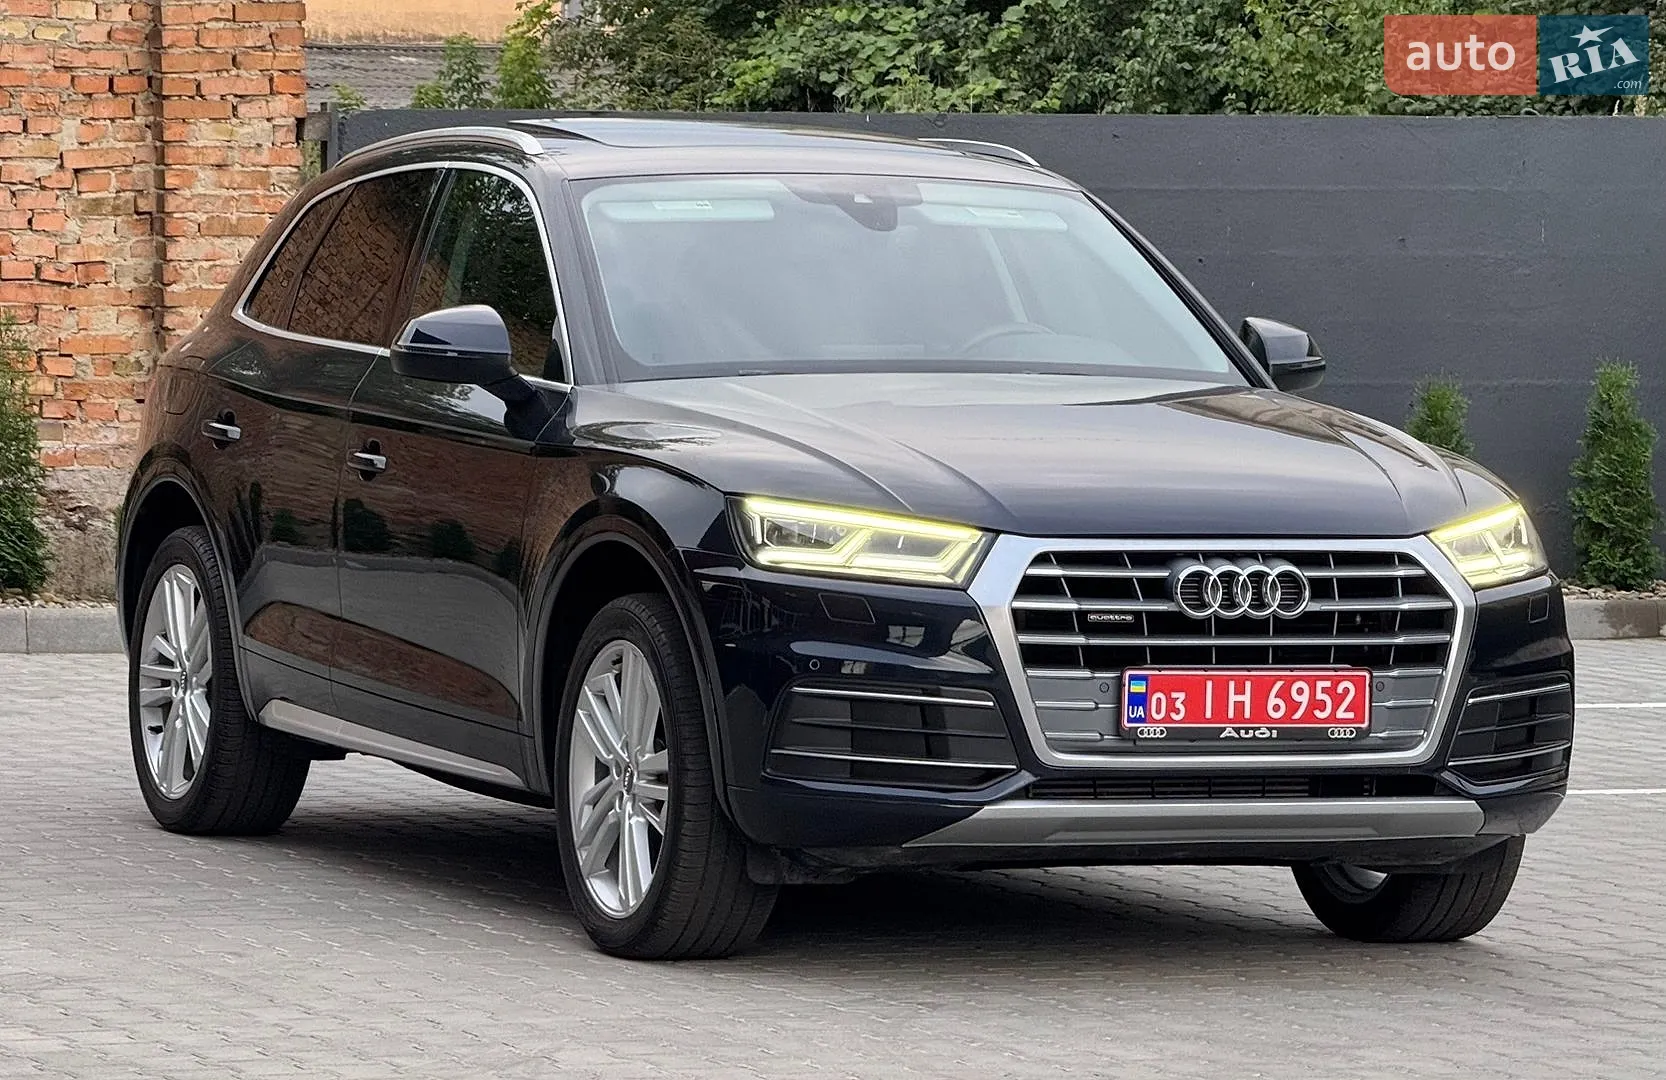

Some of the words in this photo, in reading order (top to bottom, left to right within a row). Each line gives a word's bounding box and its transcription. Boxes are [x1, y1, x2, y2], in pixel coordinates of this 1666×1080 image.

[1151, 691, 1187, 721] 03
[1266, 680, 1356, 719] 6952
[1128, 706, 1145, 719] UA
[1219, 727, 1278, 738] Audi
